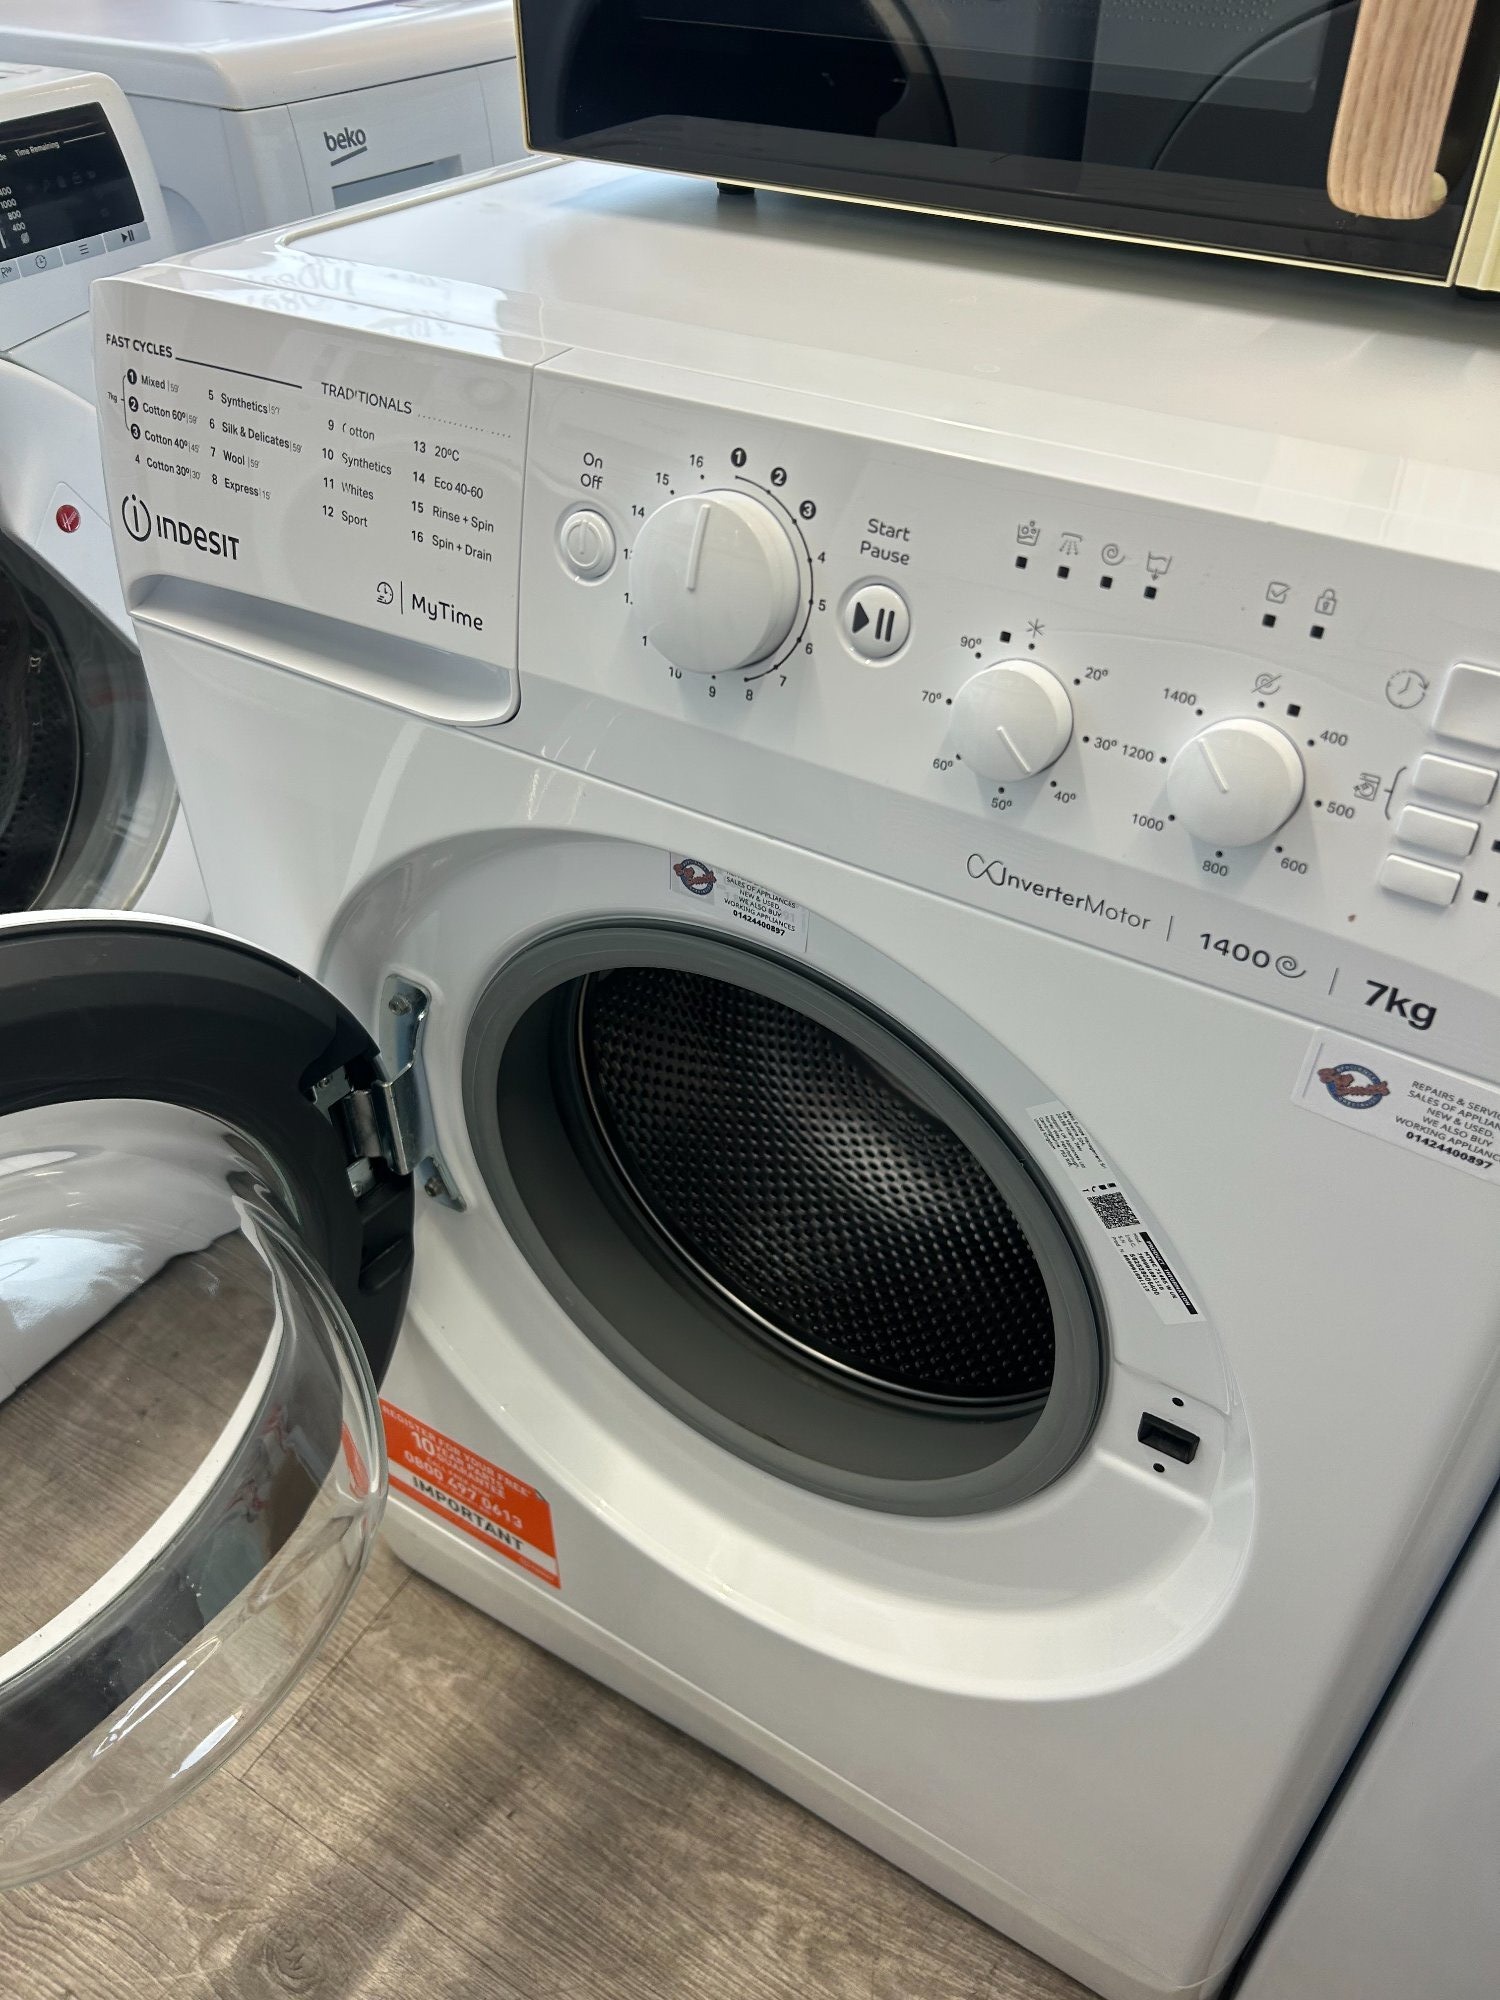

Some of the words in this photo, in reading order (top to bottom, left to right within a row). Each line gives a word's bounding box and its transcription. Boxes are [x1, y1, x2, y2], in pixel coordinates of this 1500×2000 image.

[323, 127, 367, 152] beko
[7, 210, 21, 221] 800
[12, 222, 26, 232] 400
[106, 333, 130, 349] FAST
[132, 339, 173, 358] CYCLES
[141, 374, 166, 390] Mixed
[128, 396, 139, 412] 2
[142, 402, 171, 419] Cotton
[208, 389, 214, 401] 5
[220, 392, 268, 415] Synthetics
[130, 423, 141, 440] 3
[144, 430, 173, 447] Cotton
[209, 418, 215, 430] 6
[222, 421, 238, 437] Silk
[240, 427, 247, 438] &
[247, 427, 290, 450] Delicates
[328, 419, 335, 431] 9
[210, 446, 216, 458] 7
[223, 449, 245, 466] Wool
[413, 440, 426, 454] 13
[730, 447, 747, 469] 1
[134, 454, 140, 464] 4
[146, 457, 174, 474] Cotton
[322, 447, 334, 461] 10
[341, 452, 392, 476] Synthetics
[583, 452, 603, 470] On
[689, 454, 704, 468] 16
[211, 473, 218, 485] 8
[224, 477, 259, 498] Express
[412, 471, 426, 484] 14
[433, 476, 453, 492] Eco
[454, 482, 484, 500] 40-60
[580, 474, 604, 490] Off
[655, 472, 670, 486] 15
[770, 466, 787, 488] 2
[323, 477, 334, 490] 11
[341, 481, 374, 501] Whites
[322, 505, 334, 518] 12
[341, 509, 368, 528] Sport
[411, 500, 424, 514] 15
[432, 505, 461, 525] Rinse
[462, 515, 469, 524] +
[471, 515, 494, 533] Spin
[631, 505, 645, 518] 14
[800, 499, 817, 520] 3
[867, 517, 911, 542] Start
[411, 530, 424, 543] 16
[431, 535, 454, 552] Spin
[456, 543, 462, 552] +
[465, 544, 493, 563] Drain
[817, 551, 827, 564] 4
[860, 540, 911, 566] Pause
[412, 593, 483, 631] MyTime
[817, 599, 827, 612] 5
[805, 642, 814, 656] 6
[708, 686, 717, 698] 9
[779, 675, 787, 687] 7
[745, 689, 754, 702] 8
[1163, 687, 1197, 706] 1400
[1319, 729, 1348, 747] 400
[1122, 744, 1154, 763] 1200
[1326, 801, 1356, 820] 500
[1132, 813, 1164, 832] 1000
[1202, 859, 1229, 877] 800
[1280, 857, 1308, 875] 600
[726, 876, 745, 890] SALES
[746, 883, 756, 893] OF
[757, 888, 796, 909] APPLIANCES
[739, 889, 754, 900] NEW
[723, 897, 755, 916] WORKING
[756, 912, 796, 932] APPLIANCES
[738, 896, 749, 905] WE
[749, 900, 766, 913] ALSO
[768, 907, 782, 917] BUY
[733, 909, 786, 936] 01424400897
[1200, 933, 1271, 968] 1400
[1364, 979, 1437, 1031] 7kg
[1408, 1090, 1439, 1107] SALES
[1441, 1103, 1457, 1112] OF
[1411, 1080, 1455, 1102] REPAIRS
[1456, 1098, 1465, 1106] &
[1422, 1115, 1439, 1127] WE
[1440, 1124, 1468, 1138] ALSO
[1470, 1134, 1493, 1147] BUY
[1426, 1107, 1453, 1121] NEW
[1453, 1117, 1461, 1125] &
[1464, 1121, 1494, 1139] USED.
[1394, 1115, 1446, 1140] WORKING
[1447, 1137, 1500, 1162] APPLIANC
[1406, 1131, 1493, 1169] 01424400897
[411, 1428, 436, 1458] 10
[404, 1448, 443, 1482] 0800
[448, 1475, 477, 1502] 497
[412, 1475, 523, 1552] IMPORTANT
